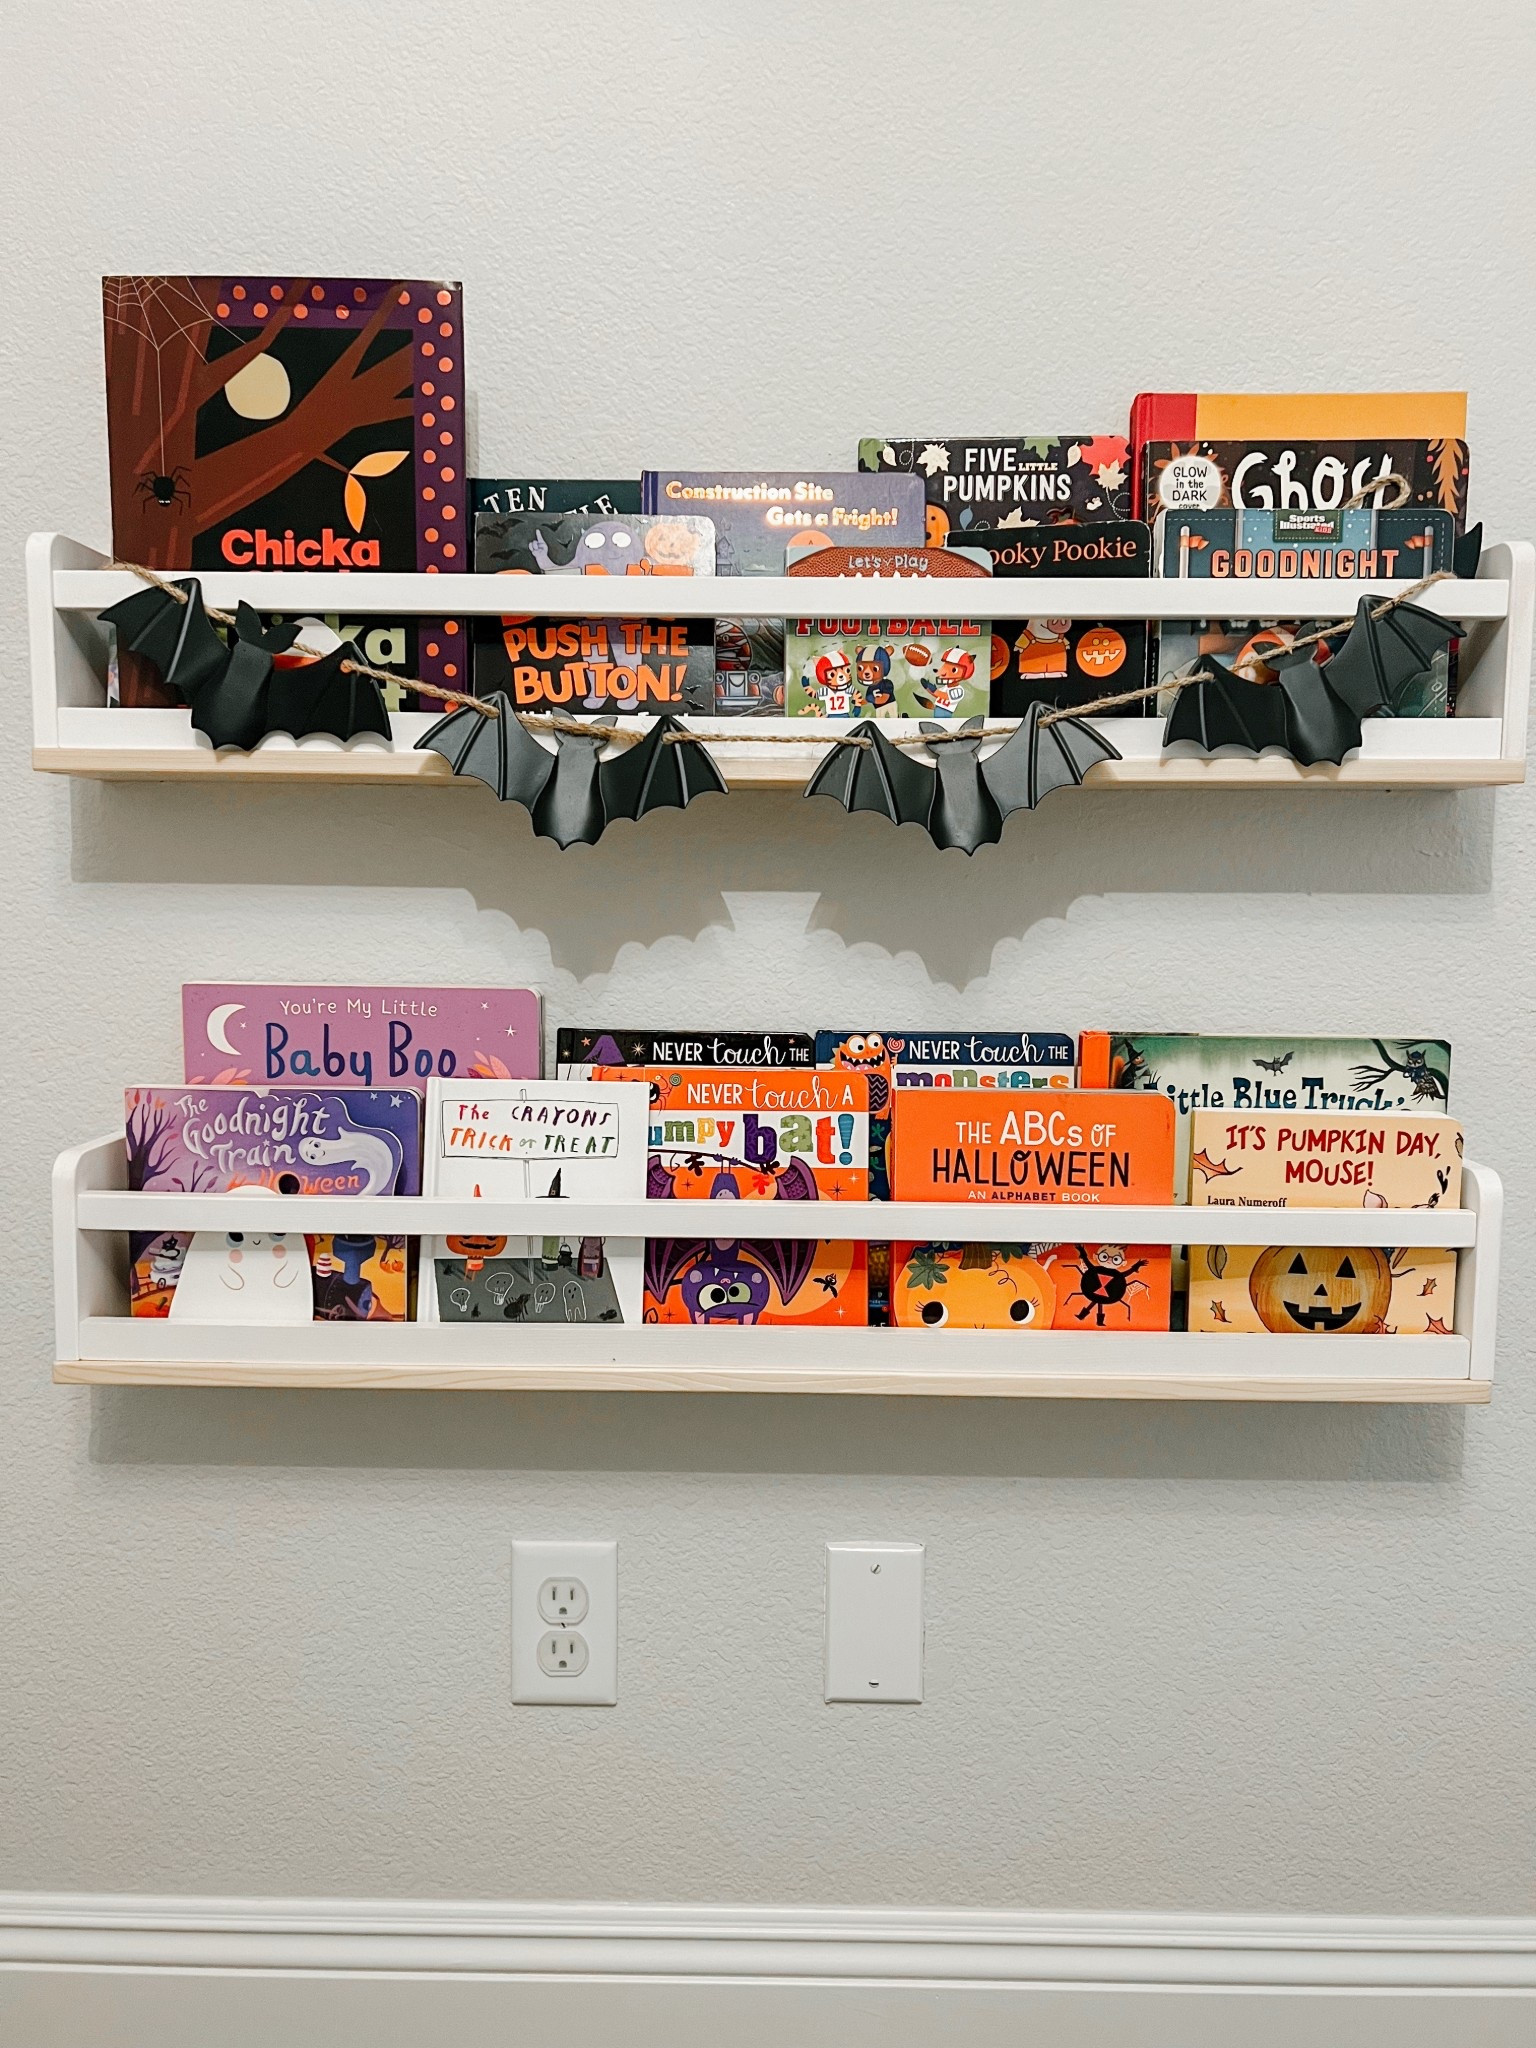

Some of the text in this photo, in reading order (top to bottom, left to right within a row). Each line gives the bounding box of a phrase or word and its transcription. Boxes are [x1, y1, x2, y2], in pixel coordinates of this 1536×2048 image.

[964, 447, 1058, 472] FIVE LITTLE
[1173, 467, 1208, 478] GLOW
[665, 480, 834, 501] Construction Site
[943, 474, 1073, 502] PUMPKINS
[1172, 490, 1208, 501] DARK
[1176, 479, 1204, 489] in the
[483, 486, 548, 514] TEN
[766, 506, 899, 531] Gets a Fright!
[1288, 514, 1325, 523] Sports
[221, 529, 381, 566] Chicka
[990, 537, 1137, 569] ooky Pookie
[848, 555, 881, 569] Let's
[1211, 549, 1399, 578] GOODNIGHT
[503, 623, 689, 663] PUSH THE
[513, 662, 688, 705] BUTTON!
[829, 696, 845, 711] 12
[280, 998, 438, 1018] You're My Little
[265, 1020, 457, 1086] Baby Boo
[652, 1035, 810, 1065] NEVER touch THE
[909, 1033, 1068, 1063] NEVER touch THE
[687, 1075, 854, 1109] NEVER touch A
[896, 1069, 1069, 1088] monsters
[174, 1095, 208, 1118] The
[1143, 1076, 1412, 1115] ittle Blue Truck'
[182, 1097, 331, 1160] Goodnight
[458, 1104, 612, 1127] The CRAYONS
[955, 1110, 1117, 1148] THE ABCs OF
[449, 1127, 616, 1154] TRICK or TREAT
[648, 1113, 855, 1166] umpy bat!
[1226, 1124, 1442, 1160] IT'S PUMPKIN DAY,
[209, 1139, 297, 1174] Train
[932, 1148, 1130, 1187] HALLOWEEN
[1285, 1158, 1374, 1187] MOUSE!
[968, 1190, 1100, 1203] AN ALPHABET BOOK
[1207, 1195, 1287, 1207] Laura Numeroff
